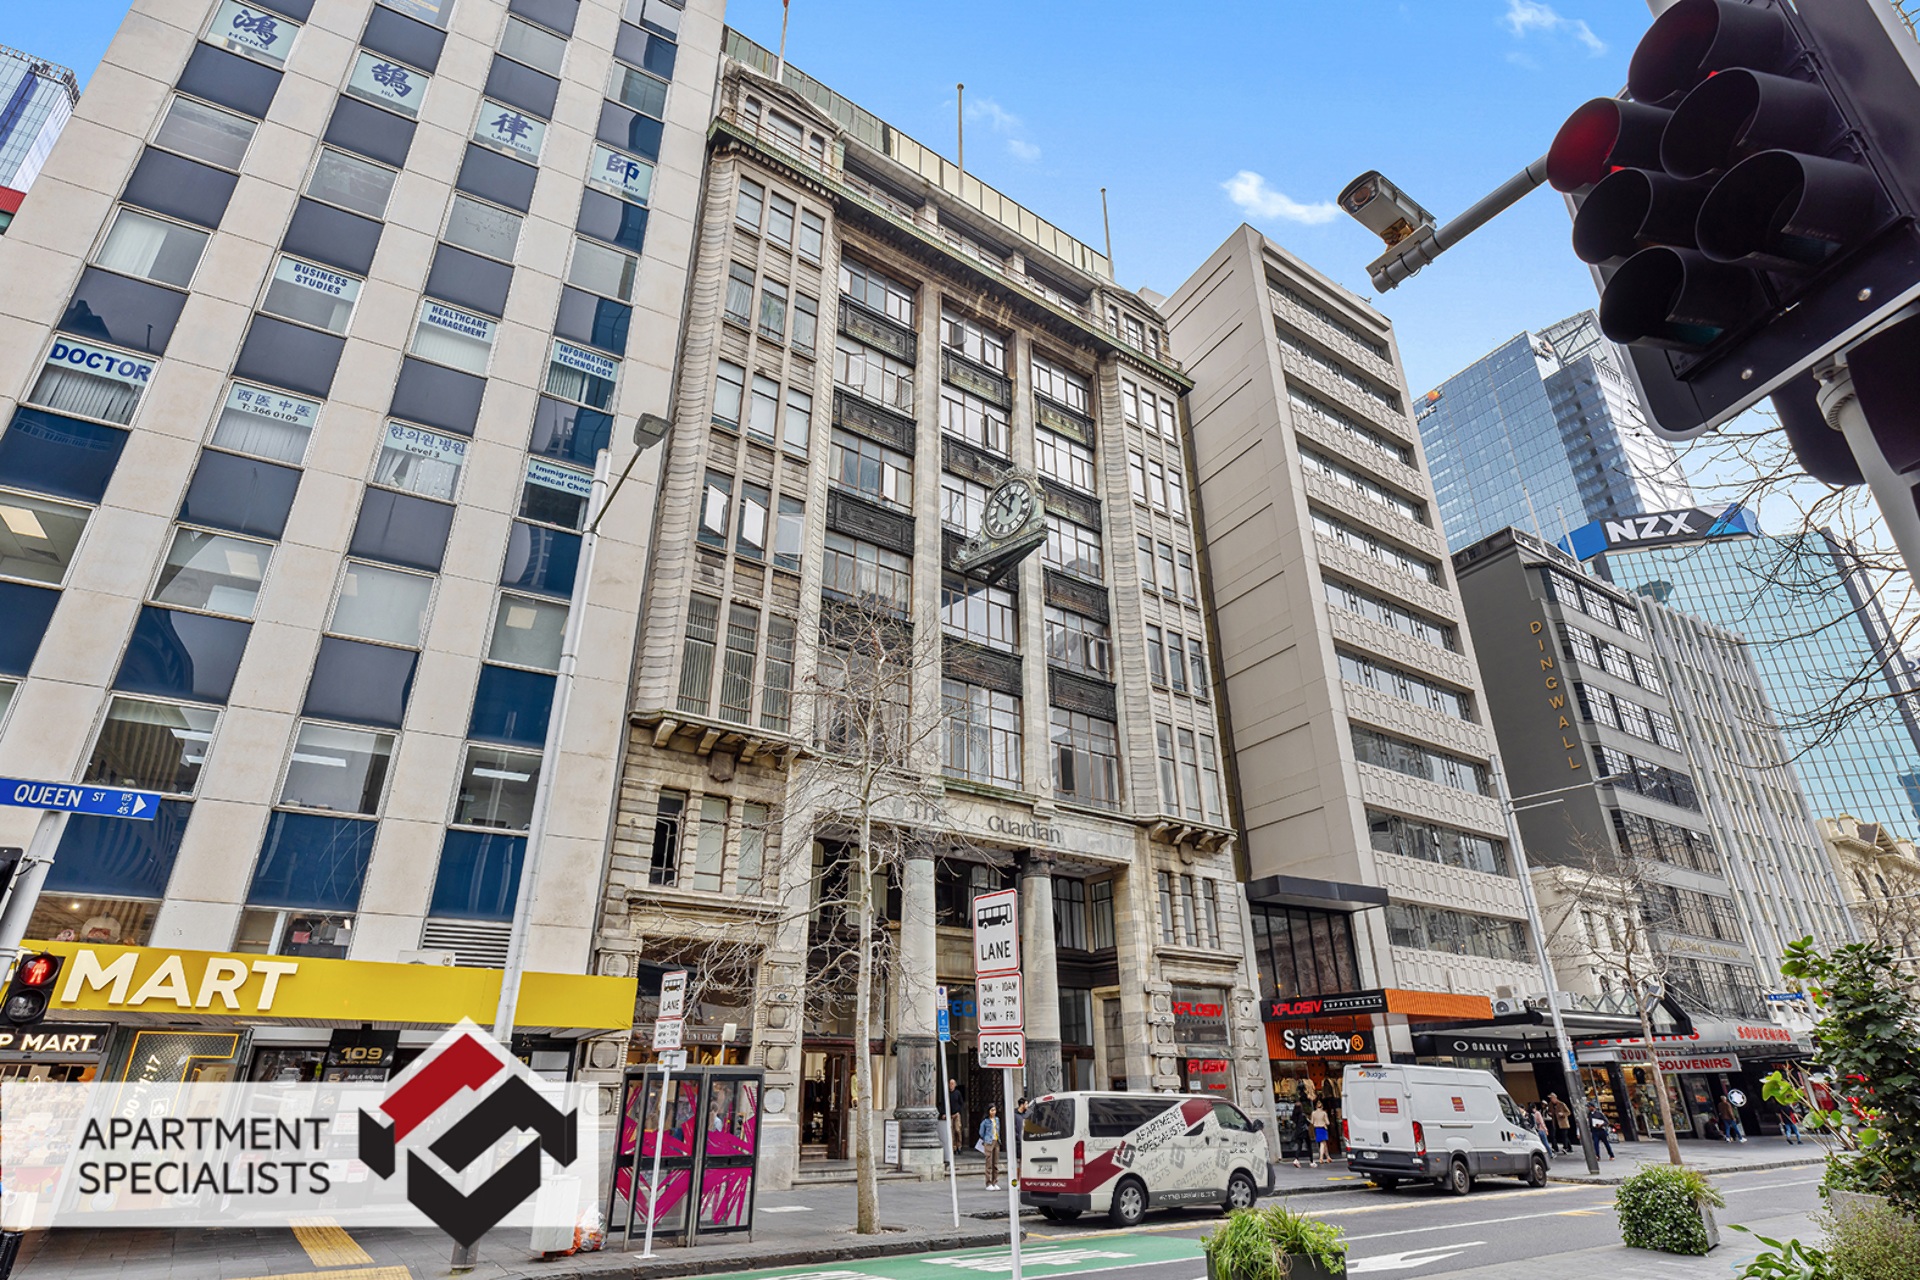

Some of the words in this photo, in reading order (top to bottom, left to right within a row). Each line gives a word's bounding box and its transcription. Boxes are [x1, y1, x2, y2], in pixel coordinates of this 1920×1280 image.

[228, 31, 269, 50] HONG
[490, 113, 533, 141] 律
[294, 263, 348, 287] BUSINESS
[295, 274, 341, 295] STUDIES
[428, 314, 486, 338] MANAGEMENT
[432, 306, 488, 330] HEALTHCARE
[50, 343, 152, 382] DOCTOR
[559, 353, 612, 378] TECHNOLOGY
[560, 345, 614, 369] INFORMATION
[406, 444, 432, 456] Level
[528, 472, 565, 487] Medical
[567, 482, 592, 494] Chec
[536, 464, 591, 485] Immigration
[1605, 511, 1697, 543] NZX
[1530, 621, 1581, 769] DINGWALL
[14, 784, 83, 807] QUEEN
[92, 792, 106, 802] ST
[117, 806, 129, 815] 45
[988, 815, 1061, 843] Guardian
[981, 940, 1011, 961] LANE
[61, 950, 299, 1011] MART
[662, 1000, 680, 1012] LANE
[1172, 1001, 1223, 1017] XPLOSIV
[1272, 1000, 1322, 1017] XPLOSIV
[20, 1034, 97, 1051] MART
[1300, 1033, 1351, 1054] Superdry
[1737, 1025, 1791, 1042] SOUVENIRS
[341, 1047, 383, 1060] 109
[983, 1041, 1020, 1058] BEGINS
[1472, 1042, 1508, 1052] OAKLEY
[1658, 1057, 1732, 1071] SOUVENIRS
[1135, 1106, 1181, 1144] APARTMENT
[1137, 1119, 1187, 1157] SPECIALISTS
